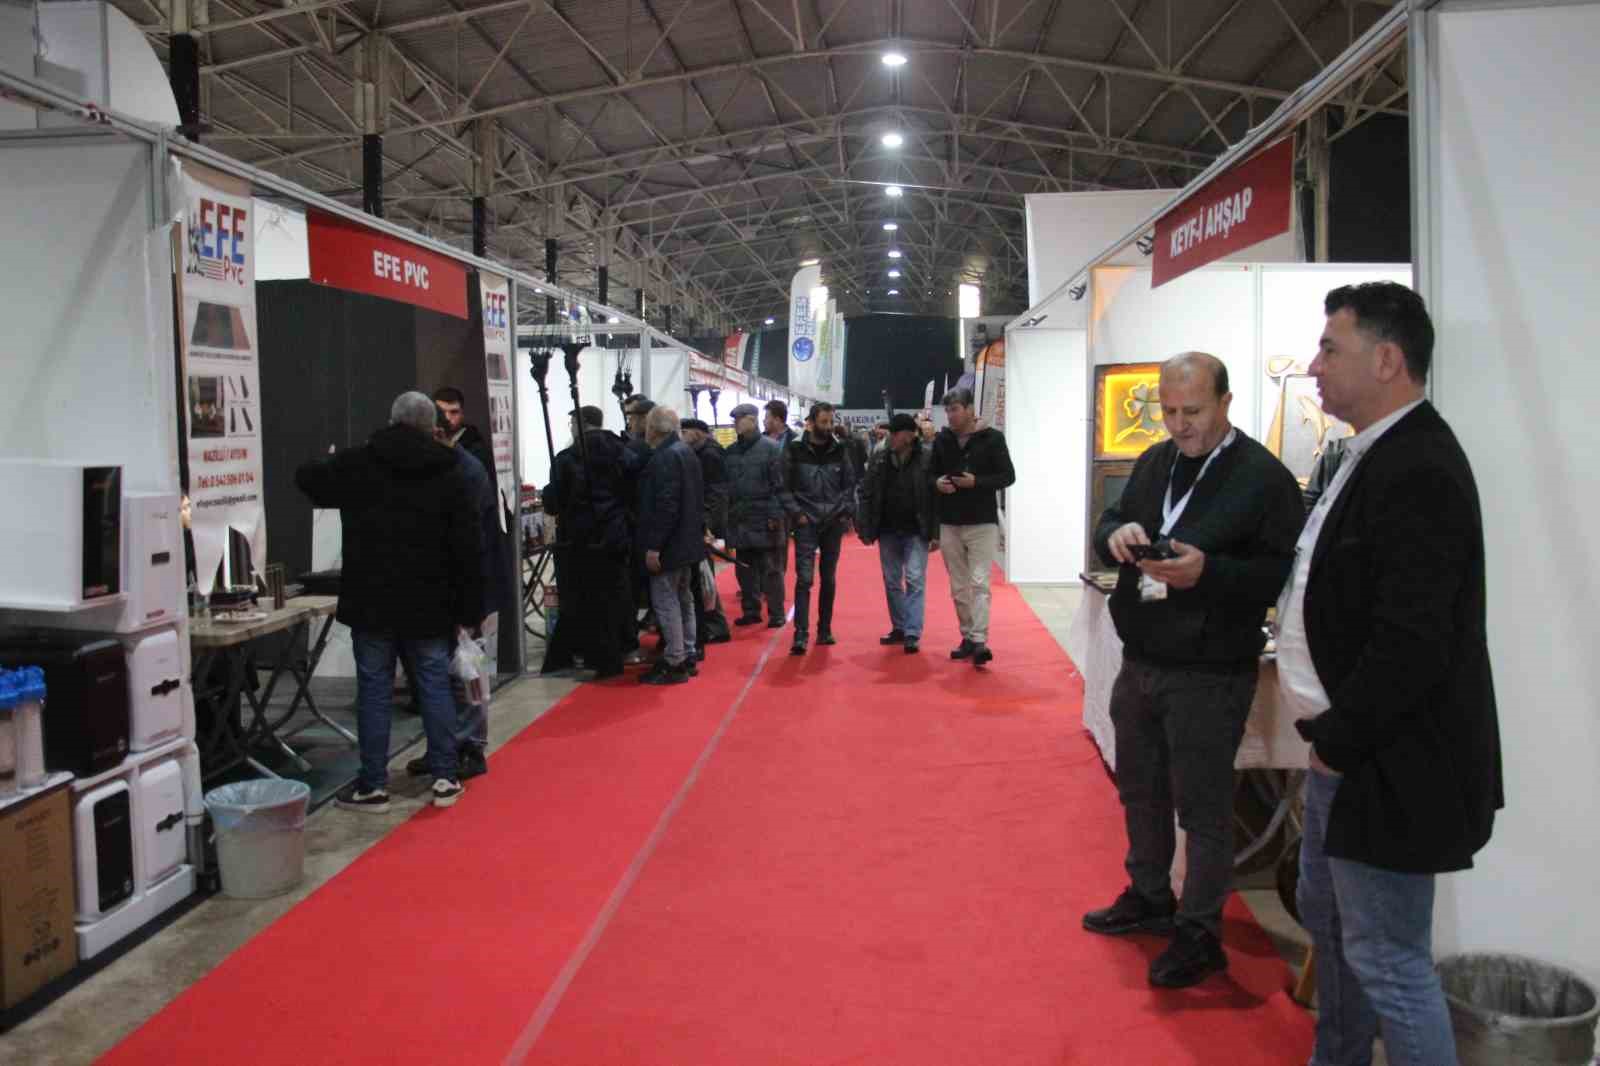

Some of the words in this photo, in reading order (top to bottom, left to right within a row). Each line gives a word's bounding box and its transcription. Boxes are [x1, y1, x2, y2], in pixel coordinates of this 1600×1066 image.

[200, 198, 247, 265] EFE
[1204, 187, 1253, 239] AHŞAP
[373, 250, 402, 282] EFE
[403, 260, 429, 290] PVC
